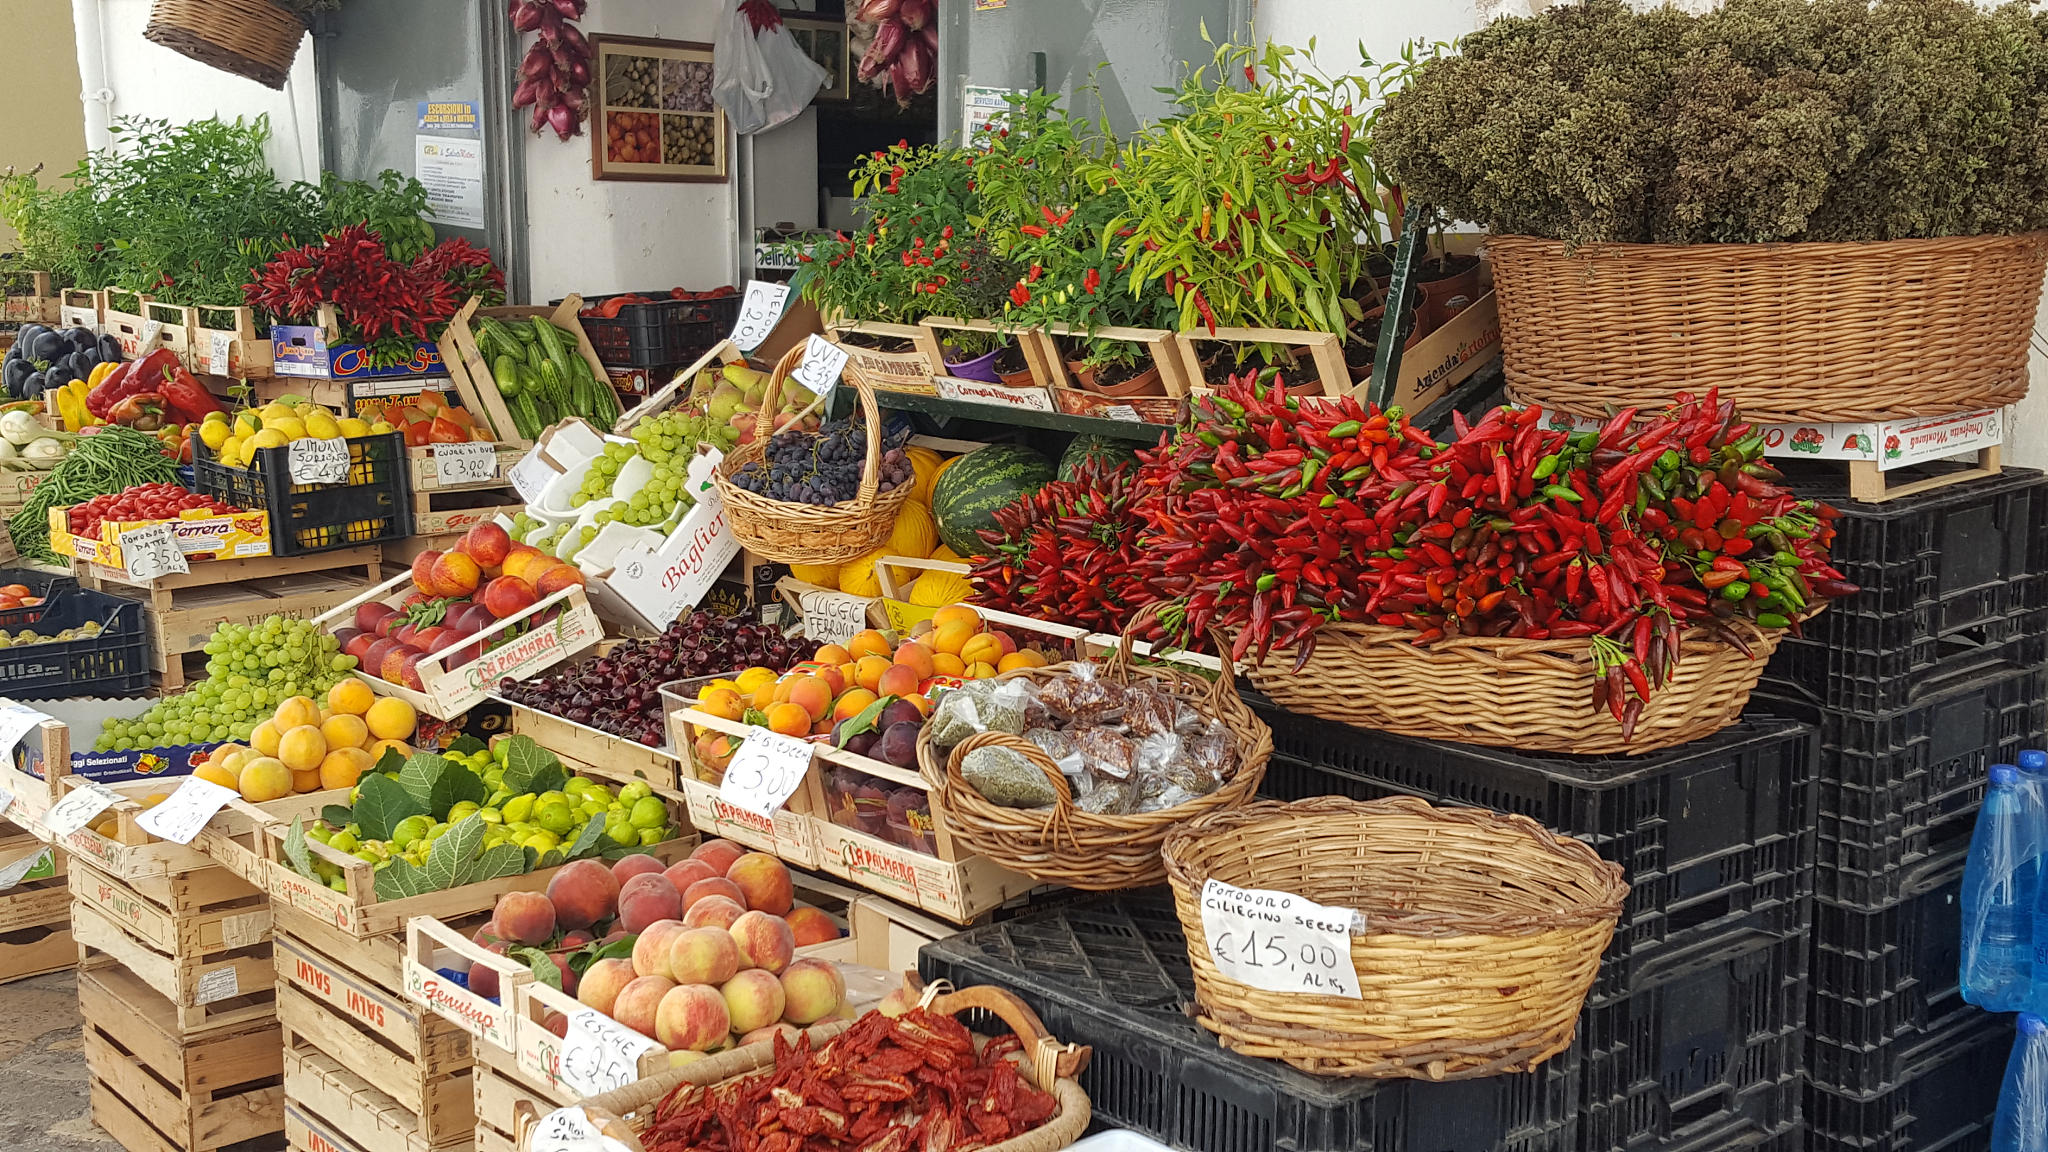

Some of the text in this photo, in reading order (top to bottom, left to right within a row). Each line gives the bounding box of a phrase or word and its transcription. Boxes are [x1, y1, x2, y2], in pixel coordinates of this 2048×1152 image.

[811, 337, 841, 368] UVA
[1413, 354, 1460, 394] Azienda
[1949, 421, 1984, 439] Ortofrutta
[168, 521, 229, 538] Ferrera
[496, 631, 557, 676] PALMARA
[86, 755, 129, 767] Selezionati
[864, 849, 918, 889] PALMARA
[1205, 898, 1282, 924] CILIEGINO
[1208, 881, 1291, 909] POMODORO
[296, 958, 332, 996] SALVI
[346, 988, 385, 1028] SALVI
[423, 980, 494, 1028] Genuino
